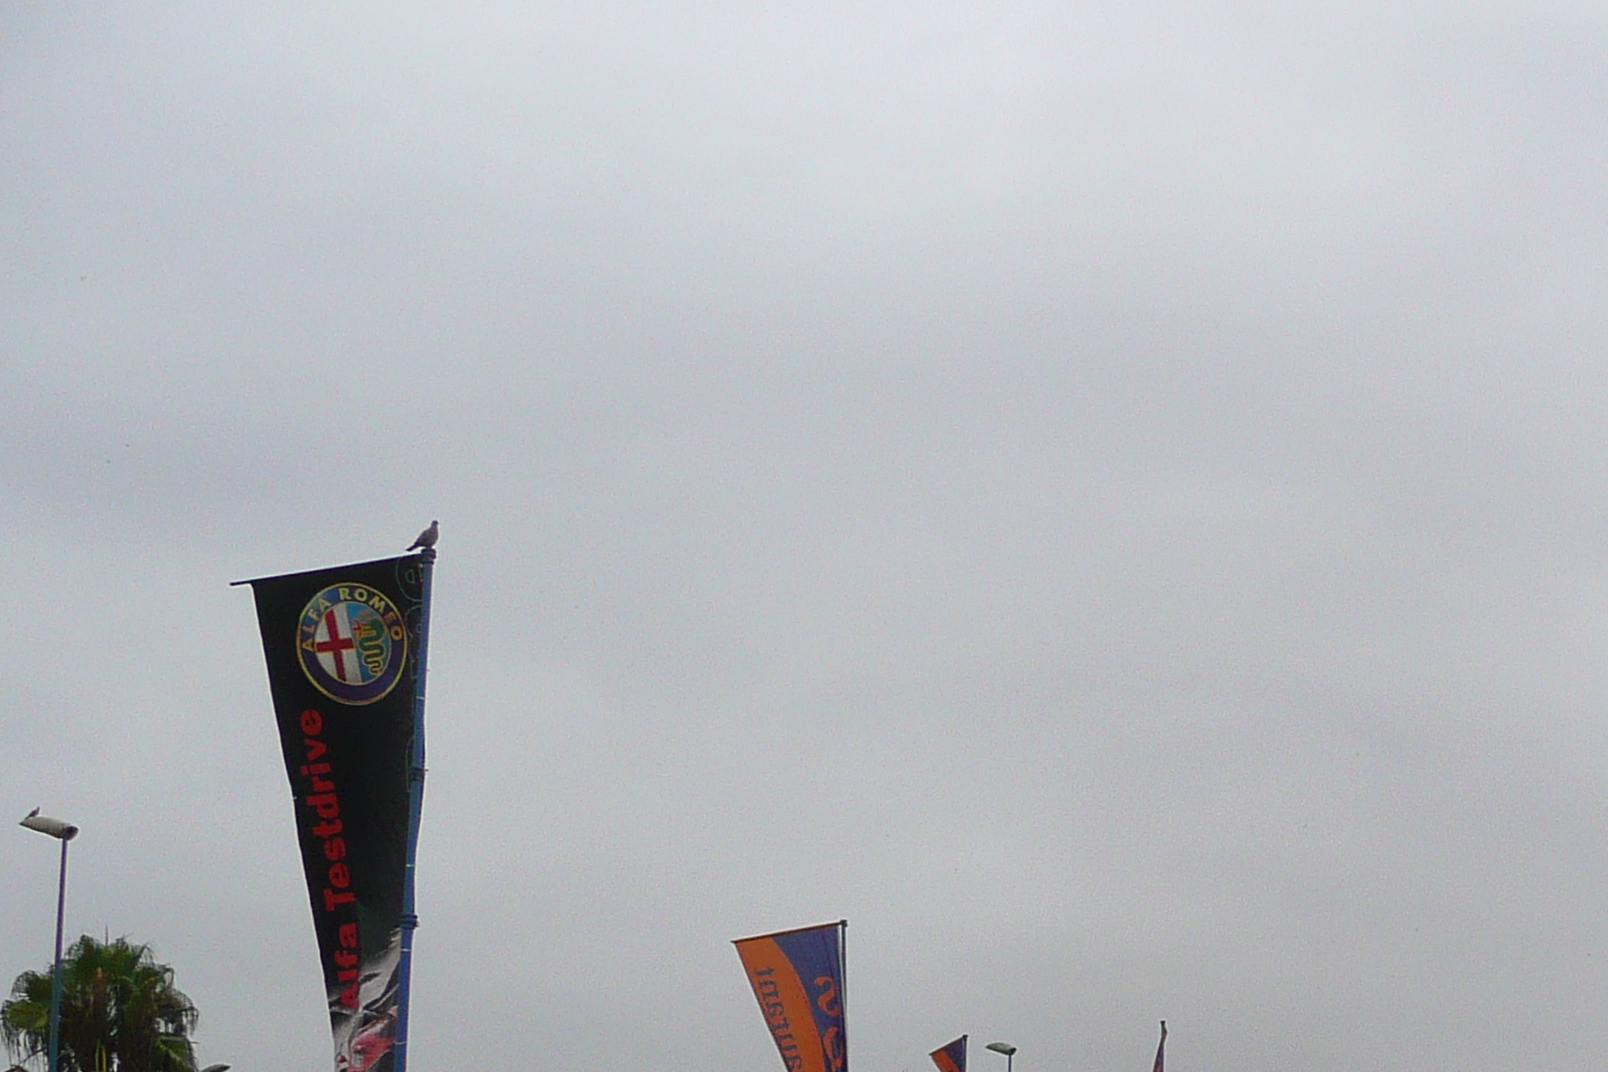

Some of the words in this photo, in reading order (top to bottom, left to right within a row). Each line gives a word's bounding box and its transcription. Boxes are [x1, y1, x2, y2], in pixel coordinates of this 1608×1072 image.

[302, 598, 332, 651] ALFA
[338, 587, 403, 641] ROMEO
[300, 708, 355, 911] Testdrive
[334, 922, 360, 1009] Alfa
